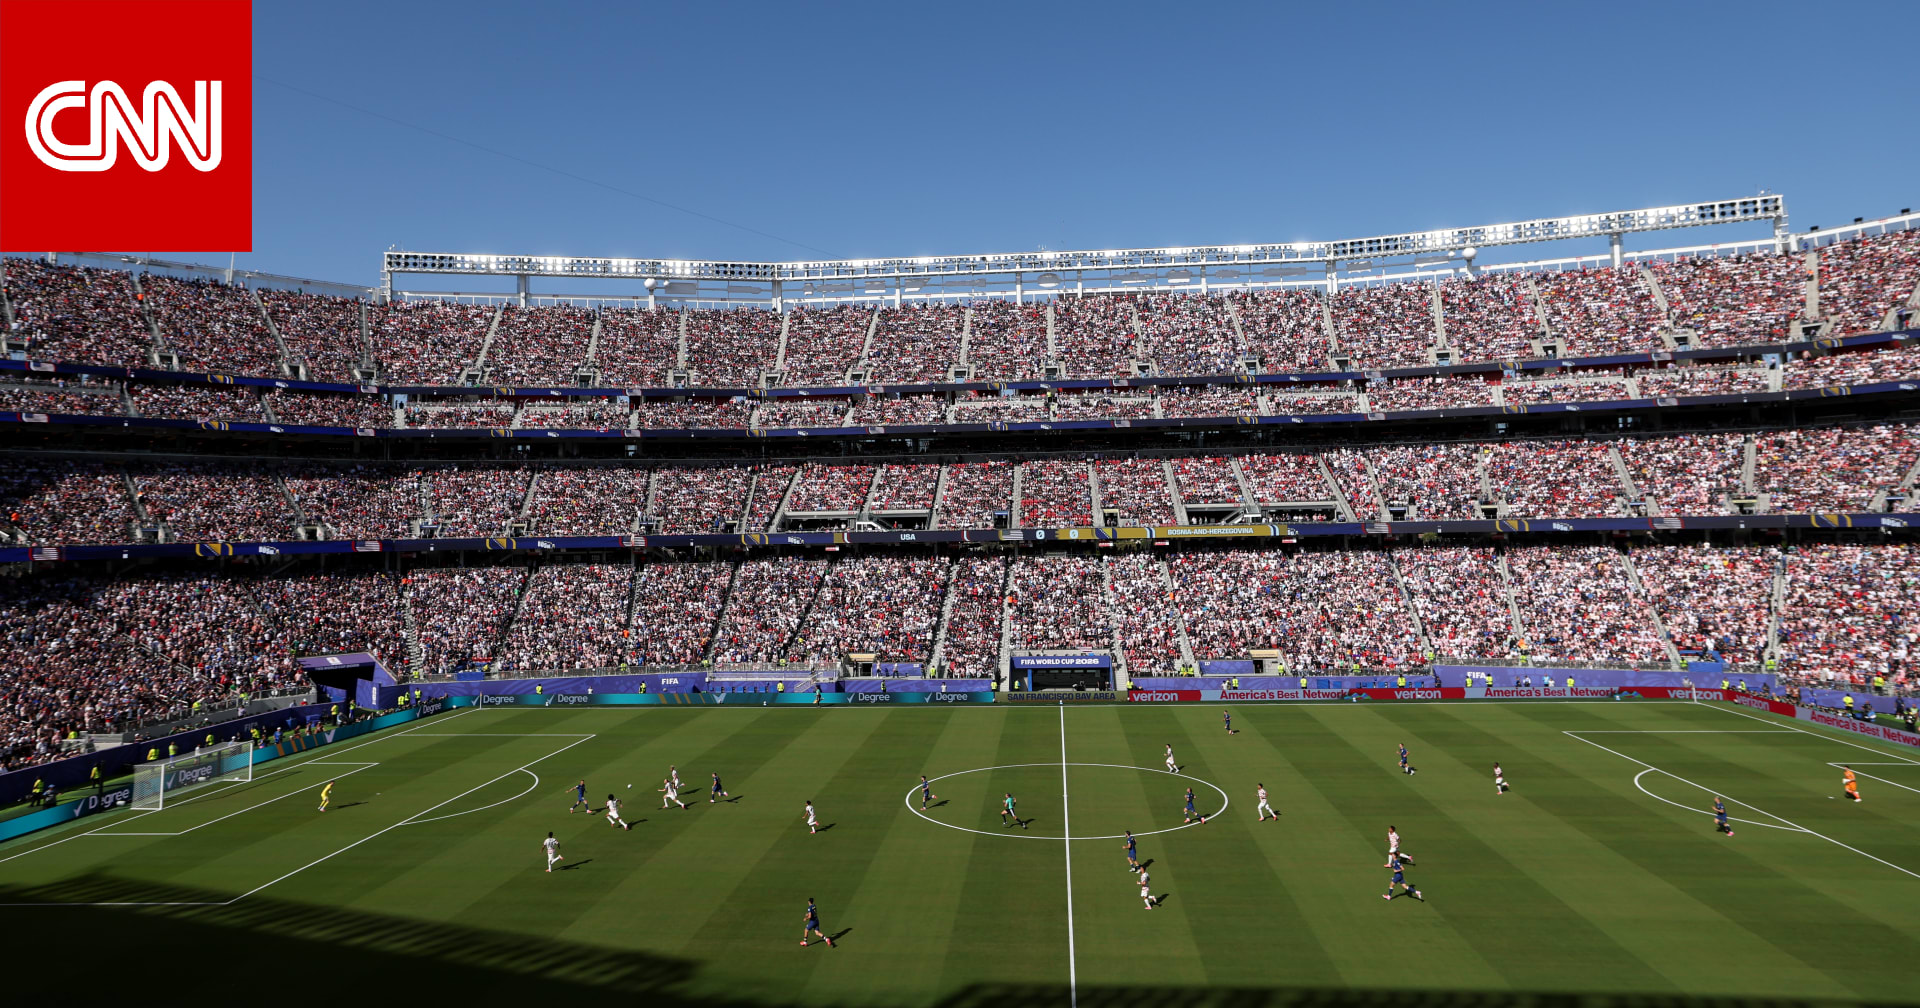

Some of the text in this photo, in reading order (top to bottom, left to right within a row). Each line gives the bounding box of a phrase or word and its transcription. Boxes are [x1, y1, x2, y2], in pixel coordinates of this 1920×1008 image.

[900, 533, 916, 541] USA
[858, 692, 890, 702] Degree
[935, 692, 968, 702] Degree
[1007, 693, 1025, 701] SAN
[1075, 692, 1091, 700] BAY
[1093, 692, 1116, 700] AREA
[1132, 690, 1179, 702] verizon
[1220, 689, 1347, 700] America's Best Network
[1394, 687, 1442, 699] verizon
[1484, 687, 1617, 697] America's Best Network
[1667, 689, 1723, 701] verzon
[483, 694, 514, 704] Degree
[557, 694, 588, 704] Degree
[423, 702, 442, 714] Degree
[1811, 710, 1857, 732] America's
[1859, 722, 1881, 737] Best
[179, 765, 212, 782] Degree
[89, 789, 130, 809] Dgree
